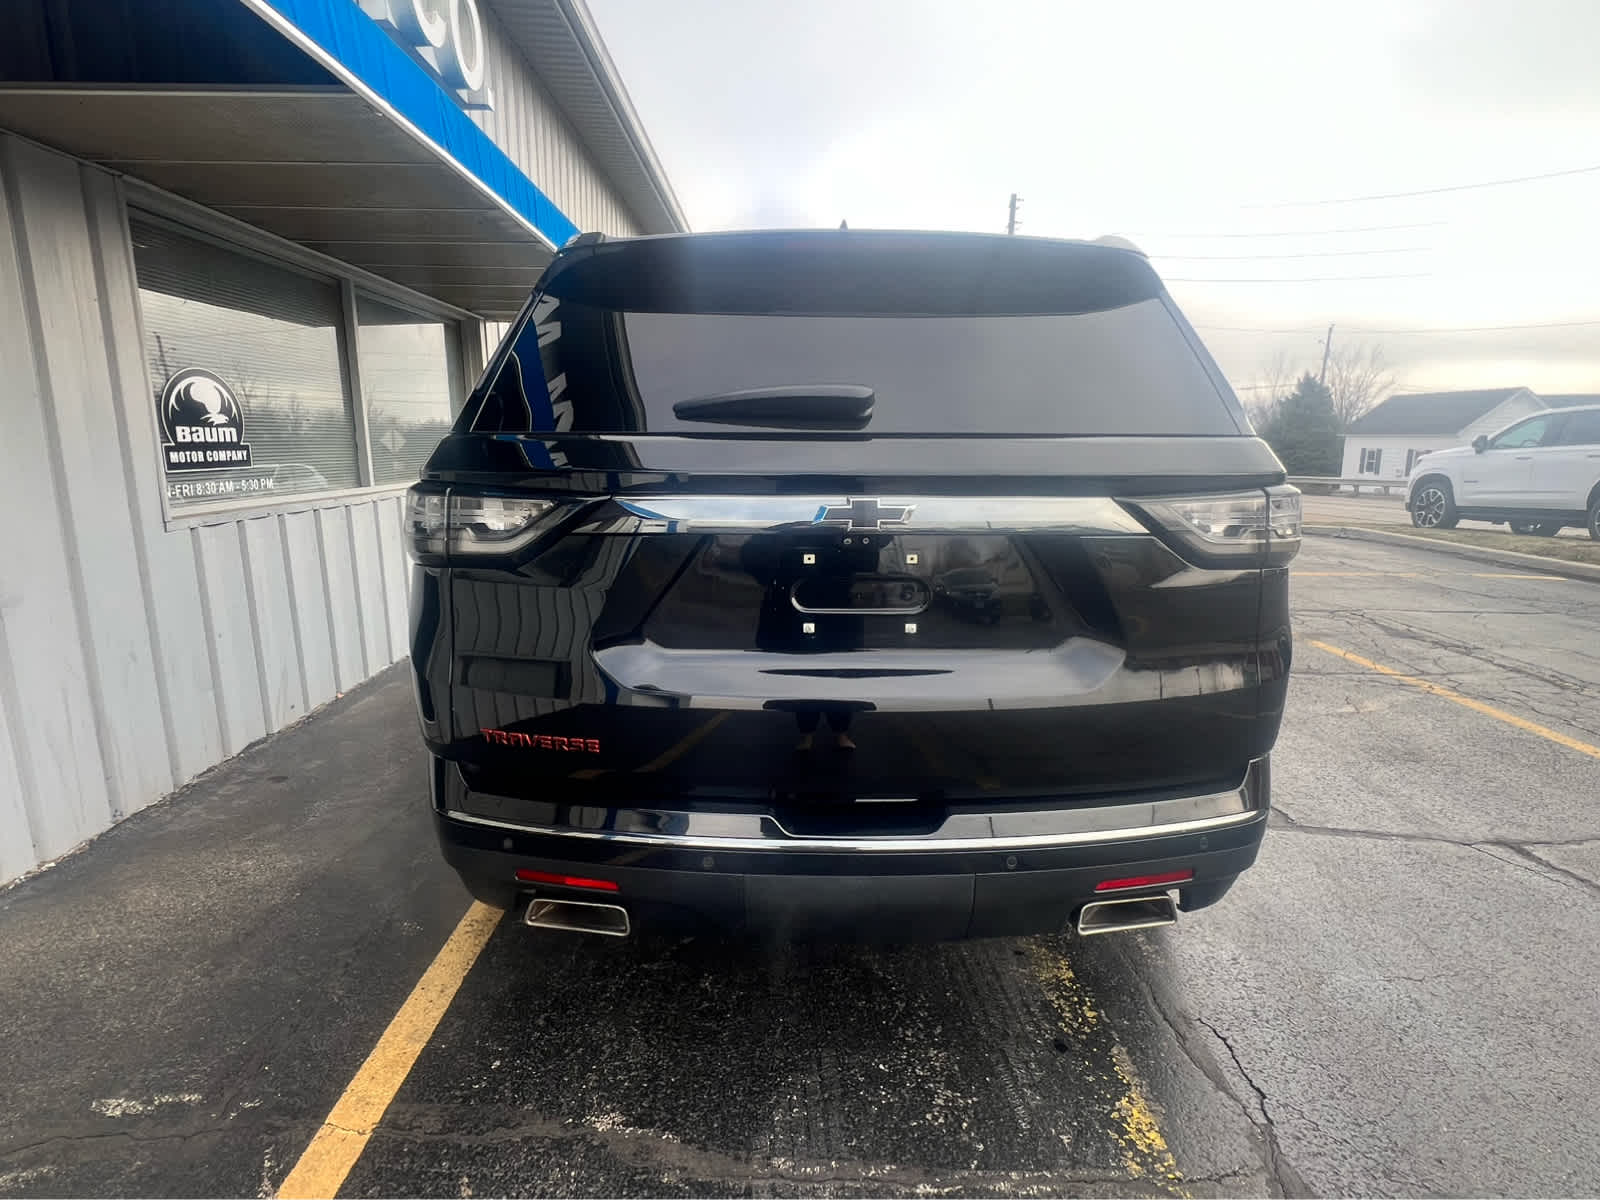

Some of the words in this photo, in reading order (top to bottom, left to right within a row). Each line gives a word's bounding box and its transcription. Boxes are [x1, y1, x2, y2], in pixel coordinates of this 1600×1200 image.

[169, 451, 205, 463] MOTOR
[206, 449, 248, 462] COMPANY
[196, 481, 217, 496] 8:30
[218, 480, 234, 494] AM
[241, 478, 259, 491] 5:30
[260, 477, 274, 490] PM
[480, 728, 600, 753] TRAVERSE
